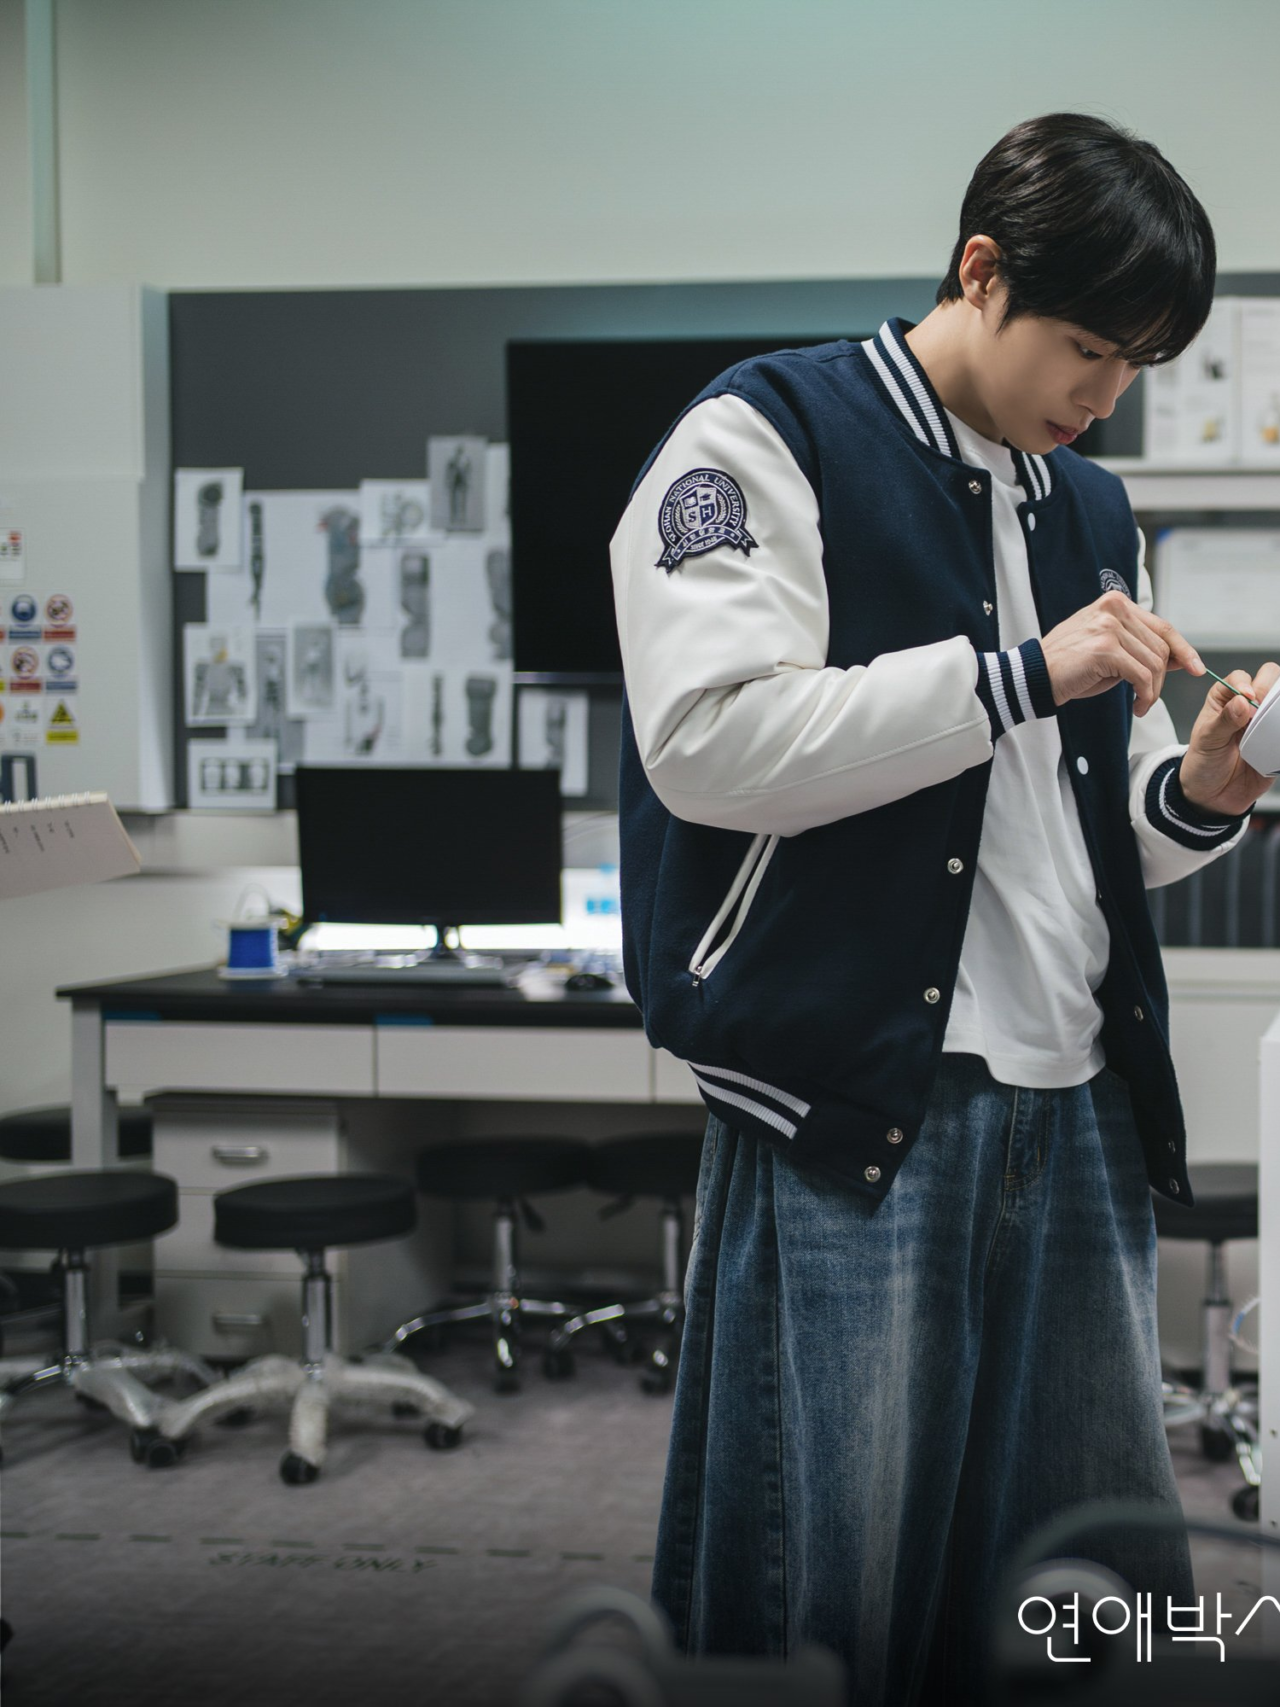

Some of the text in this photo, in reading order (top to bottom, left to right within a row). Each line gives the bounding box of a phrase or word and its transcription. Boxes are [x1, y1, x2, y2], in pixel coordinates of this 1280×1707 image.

[664, 474, 740, 542] SEOHAN NATIONAL UNIVERSITY
[688, 506, 712, 522] S H
